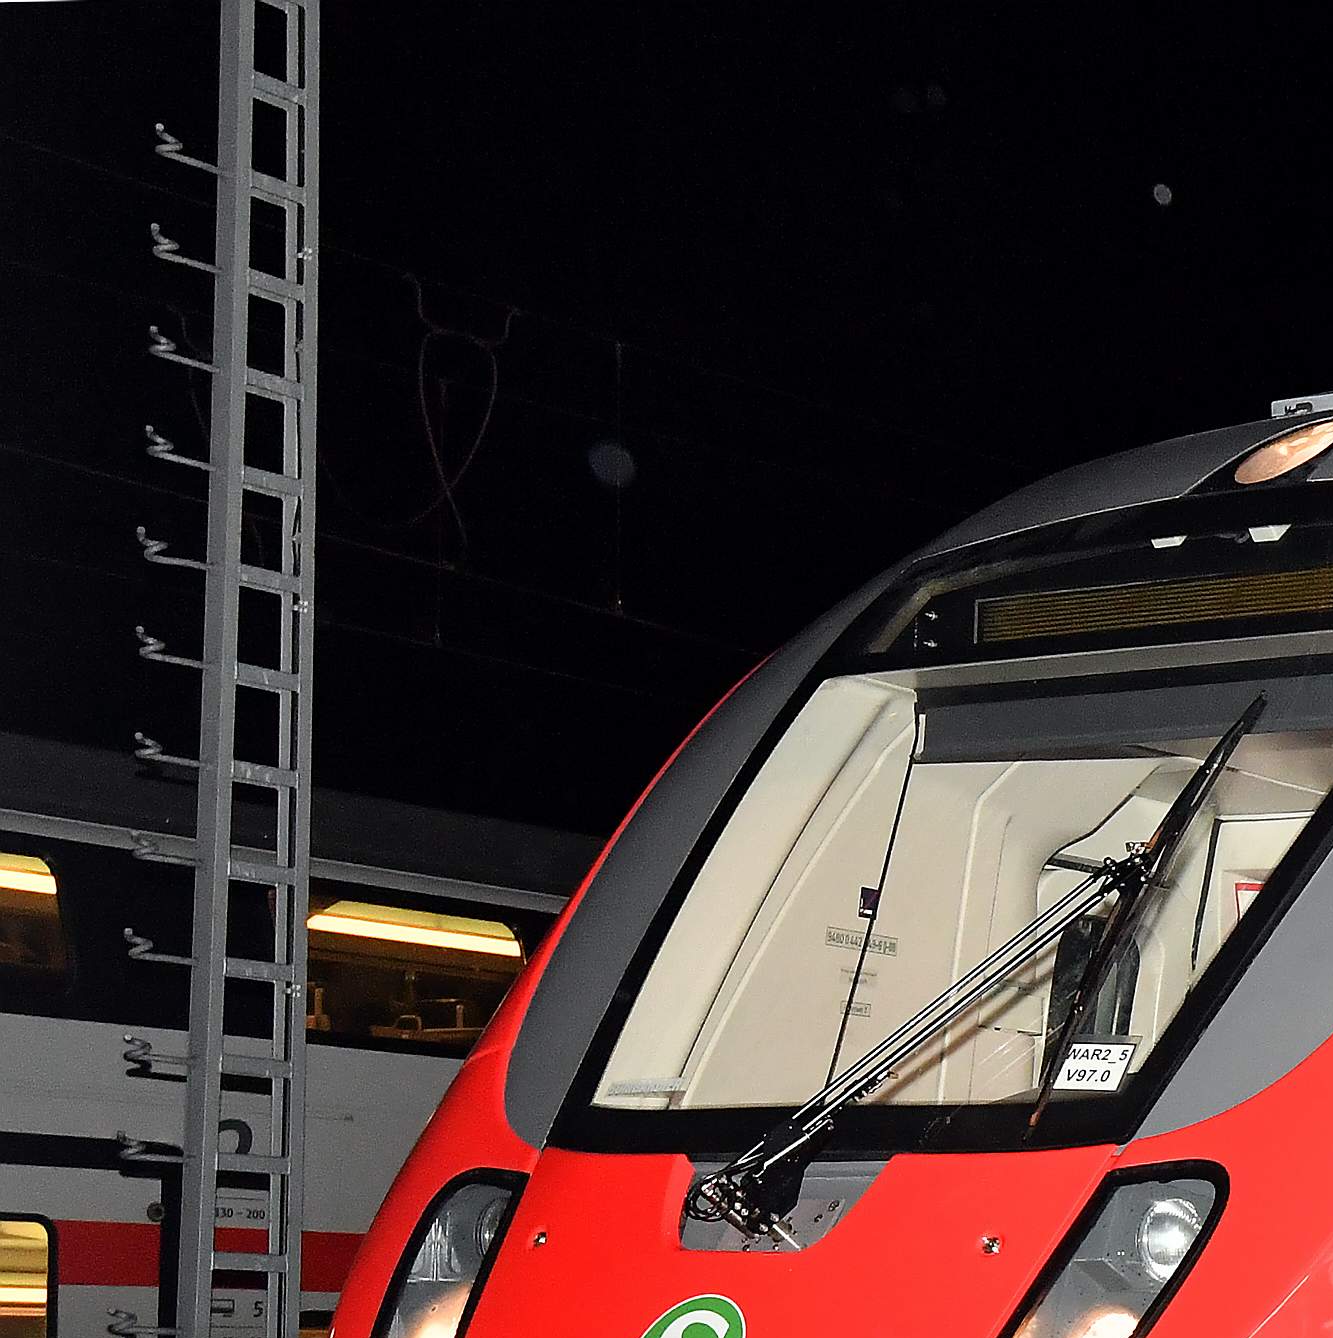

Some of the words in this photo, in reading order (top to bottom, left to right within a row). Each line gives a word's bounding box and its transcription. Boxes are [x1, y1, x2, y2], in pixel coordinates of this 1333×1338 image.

[1066, 1069, 1111, 1083] V97.0
[246, 1208, 266, 1220] 200
[253, 1301, 264, 1318] 5
